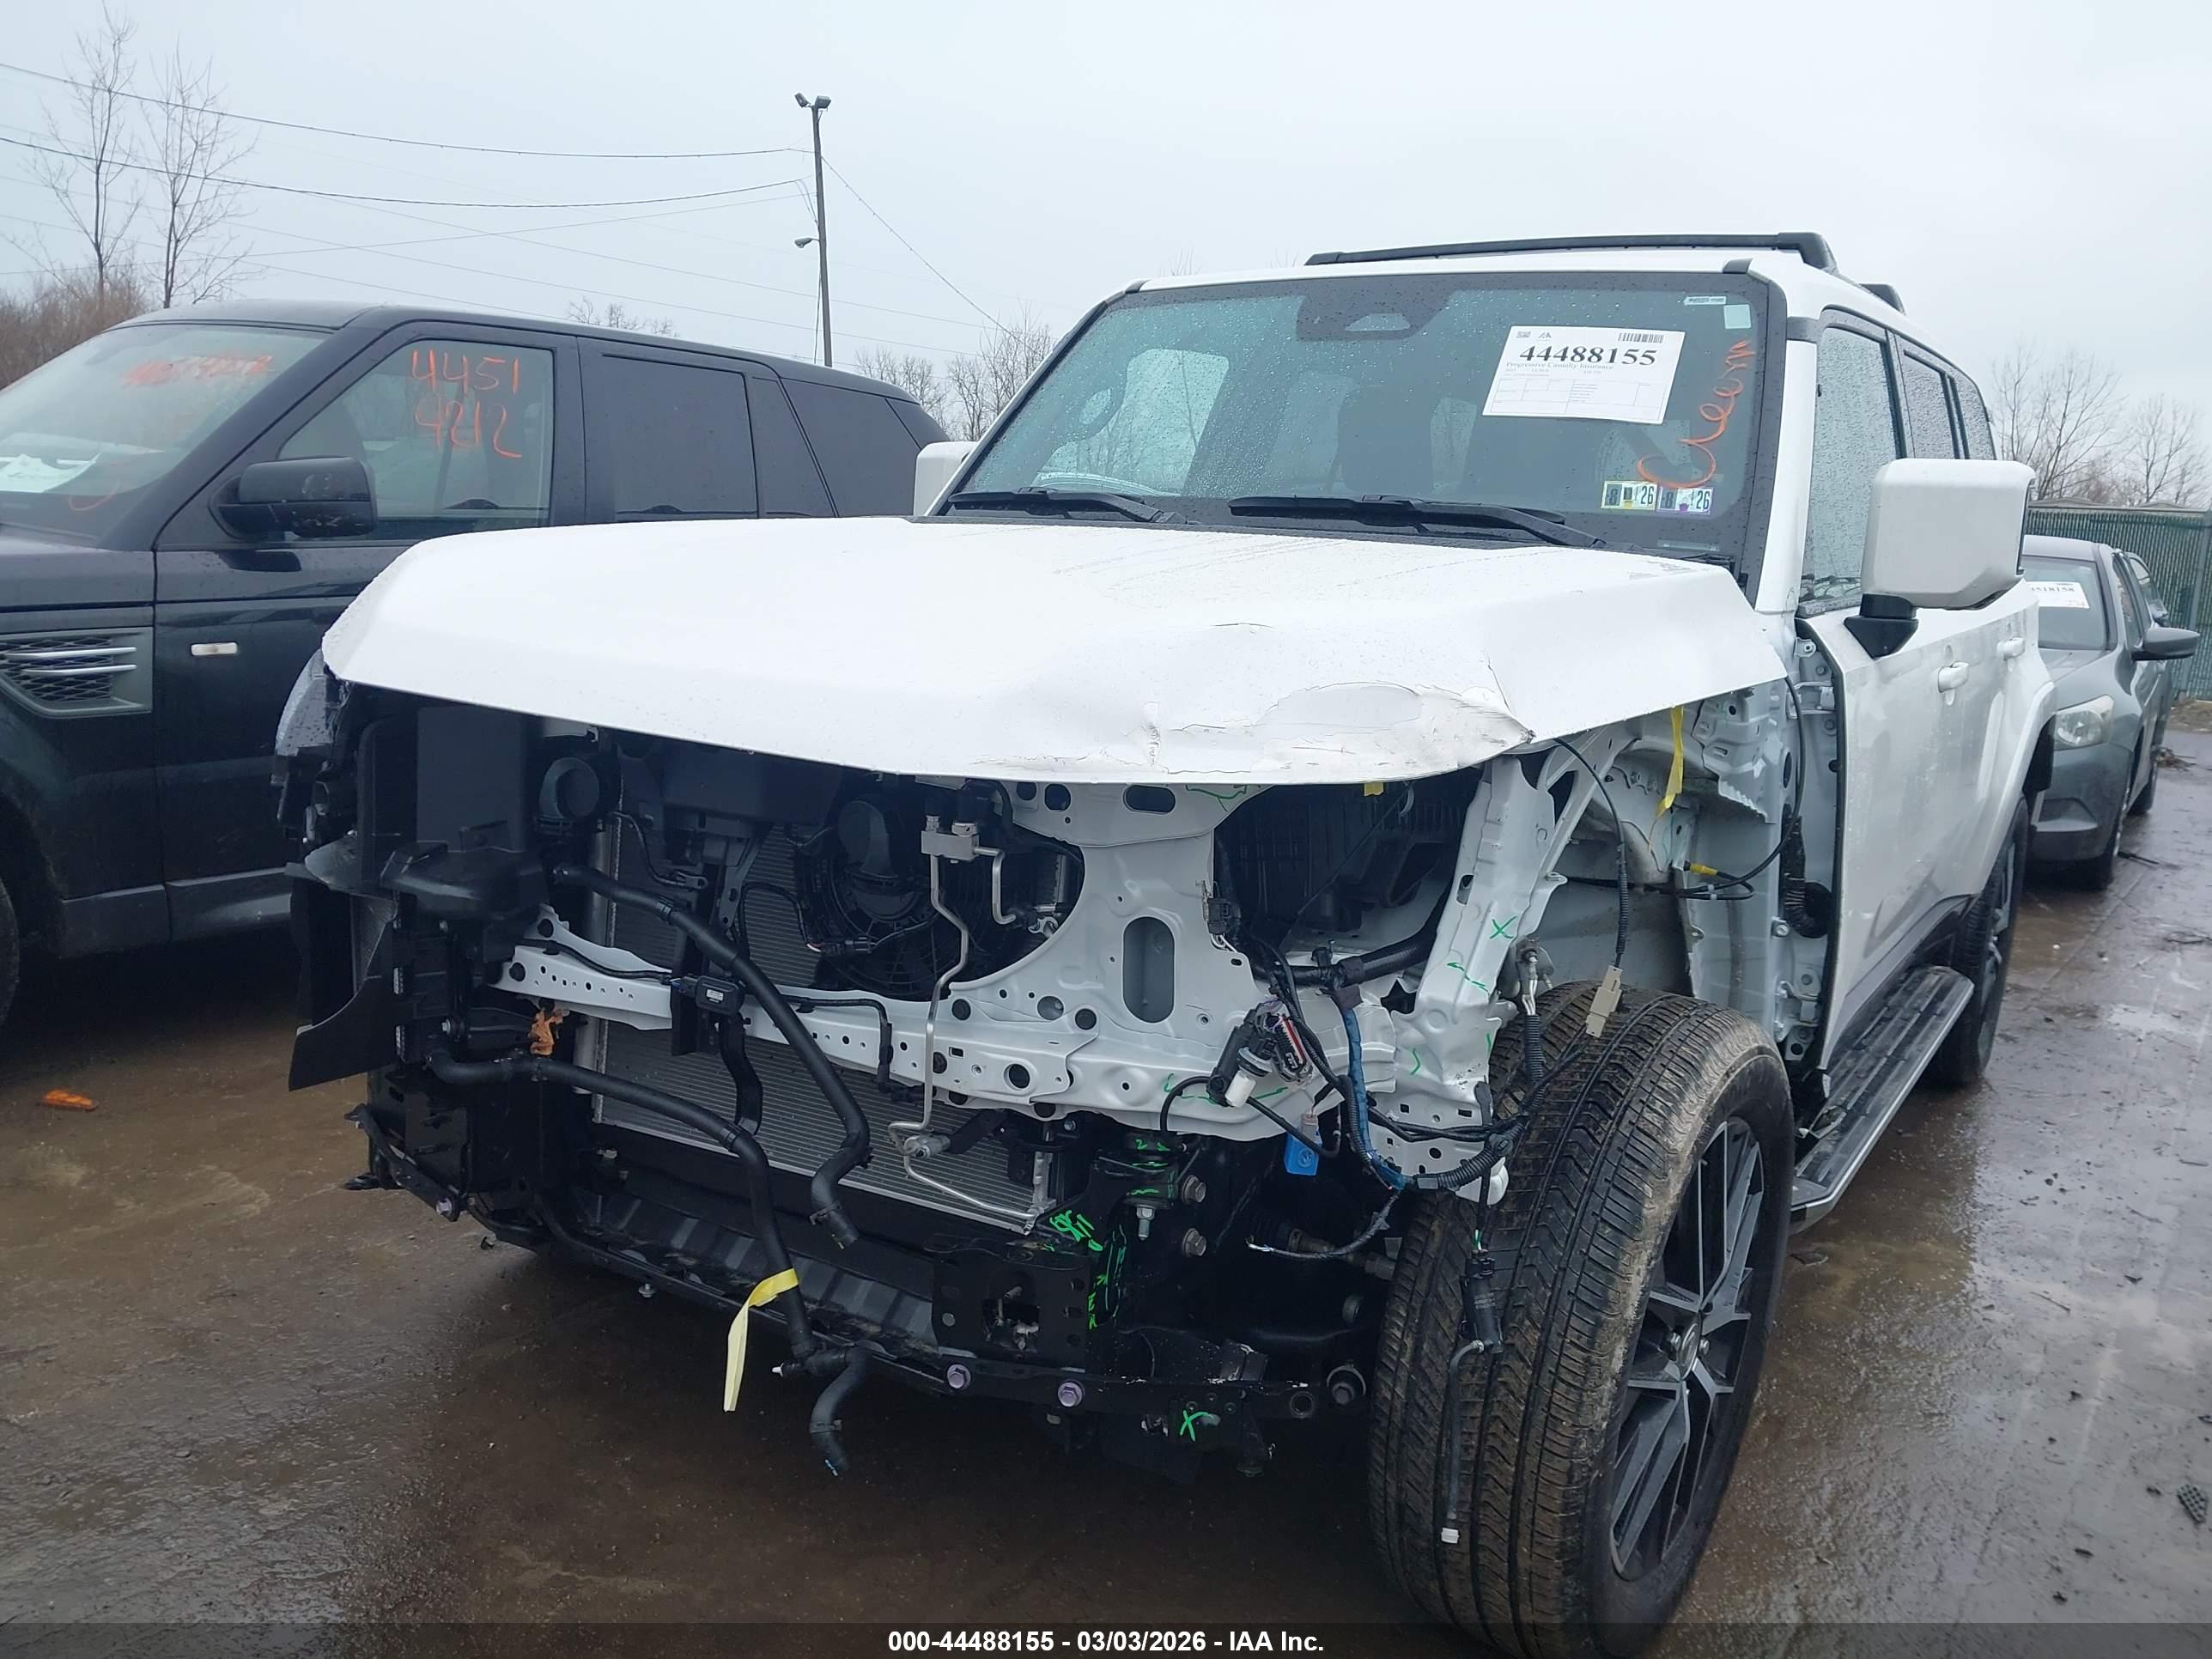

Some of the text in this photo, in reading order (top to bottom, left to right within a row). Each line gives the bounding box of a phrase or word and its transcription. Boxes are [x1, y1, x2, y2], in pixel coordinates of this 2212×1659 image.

[1519, 345, 1657, 366] 44488155
[412, 349, 520, 395] 4451
[1640, 485, 1655, 506] 26
[1696, 489, 1711, 510] 26
